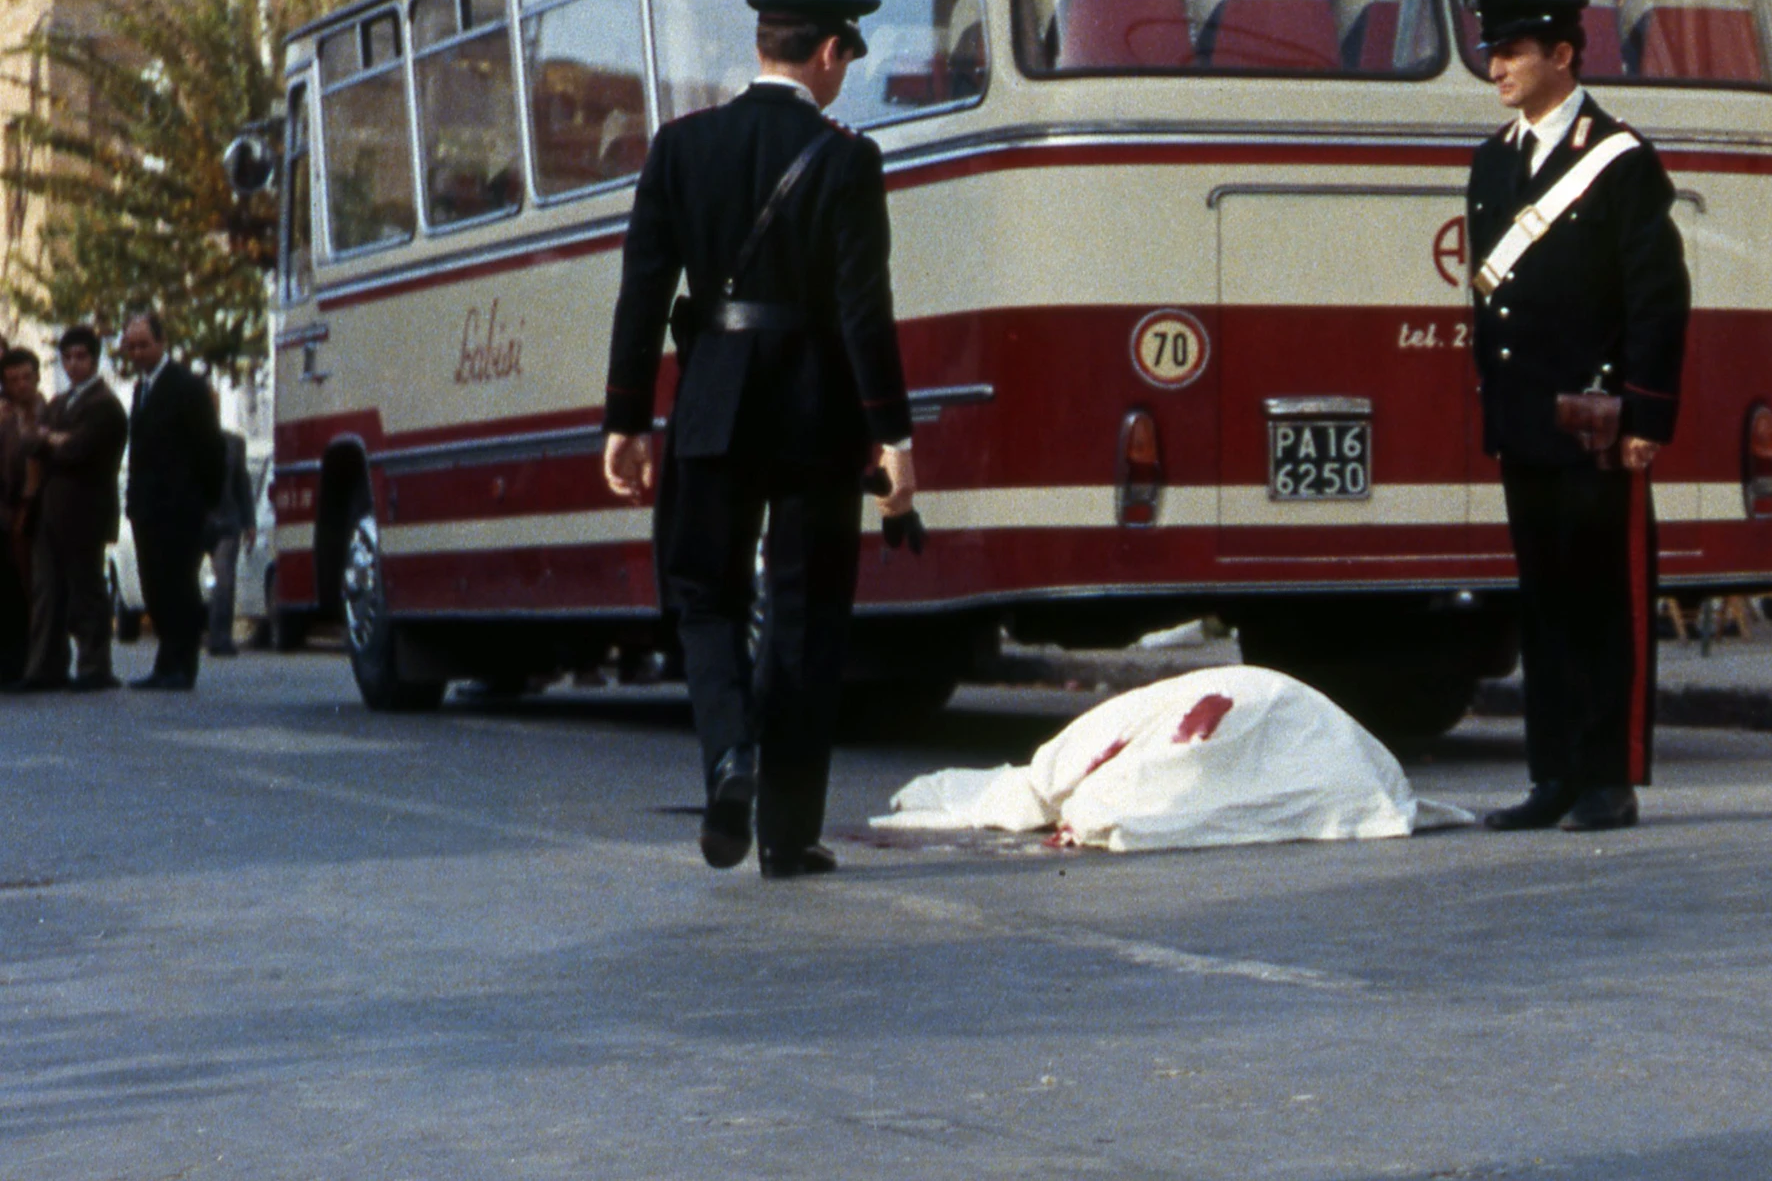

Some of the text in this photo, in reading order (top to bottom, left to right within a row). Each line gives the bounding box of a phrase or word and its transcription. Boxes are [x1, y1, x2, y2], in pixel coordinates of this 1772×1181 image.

[1151, 331, 1188, 368] 70
[1451, 321, 1475, 348] 2
[1274, 462, 1365, 496] 6250
